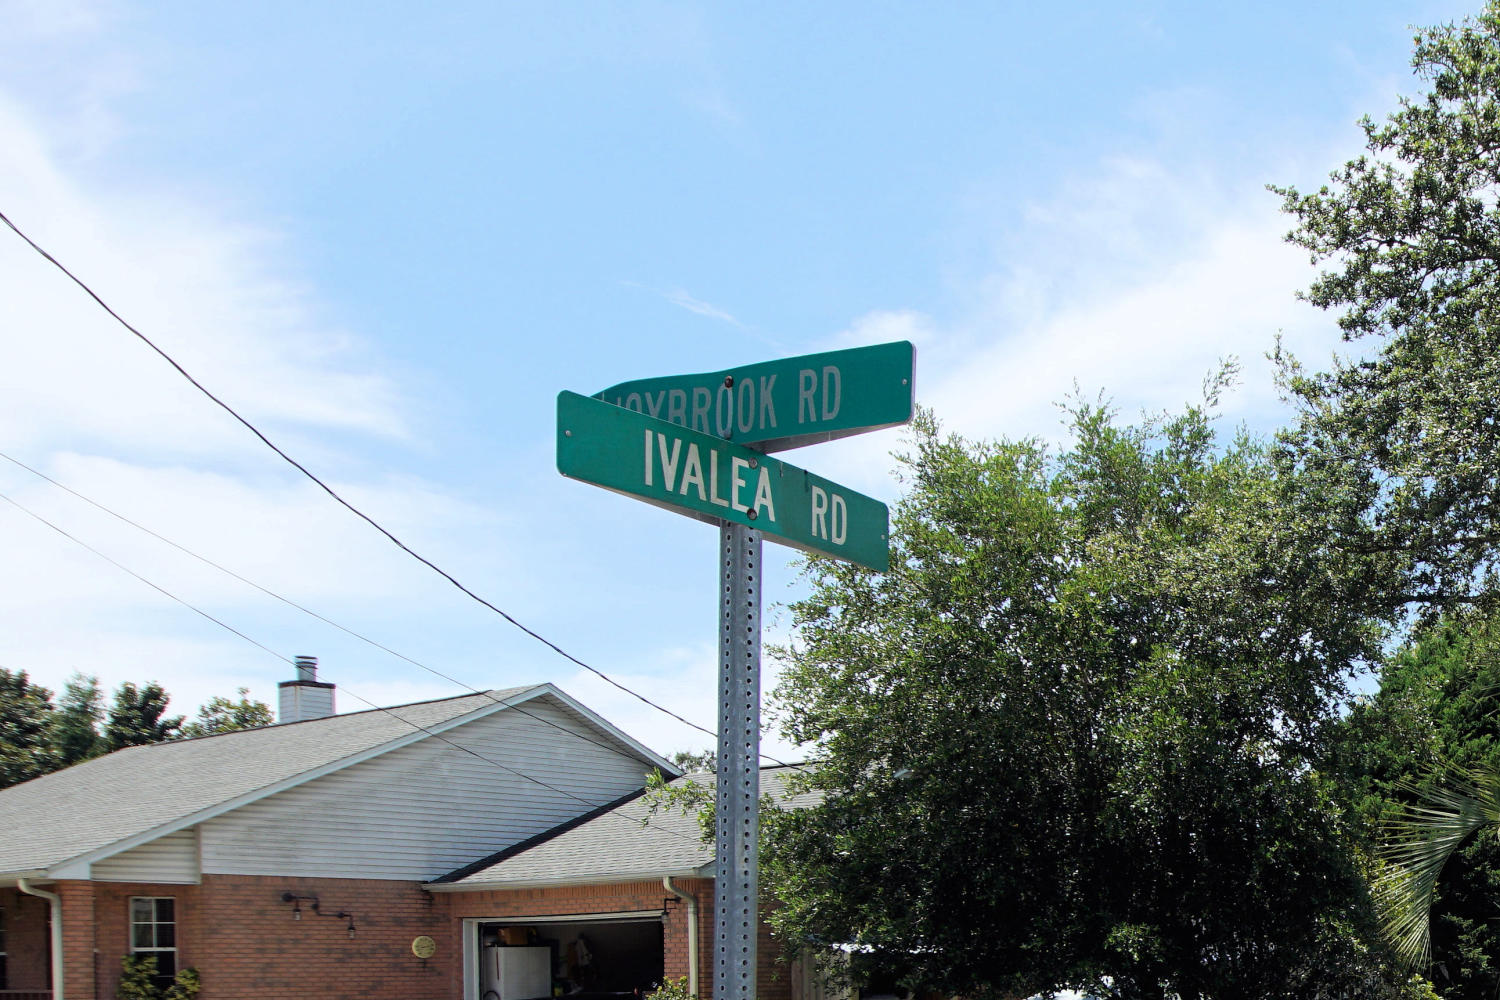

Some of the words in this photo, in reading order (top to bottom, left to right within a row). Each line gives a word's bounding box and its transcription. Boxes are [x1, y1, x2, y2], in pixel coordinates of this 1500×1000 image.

[798, 365, 842, 424] RD
[644, 429, 776, 522] IVALEA
[810, 485, 848, 546] RD
